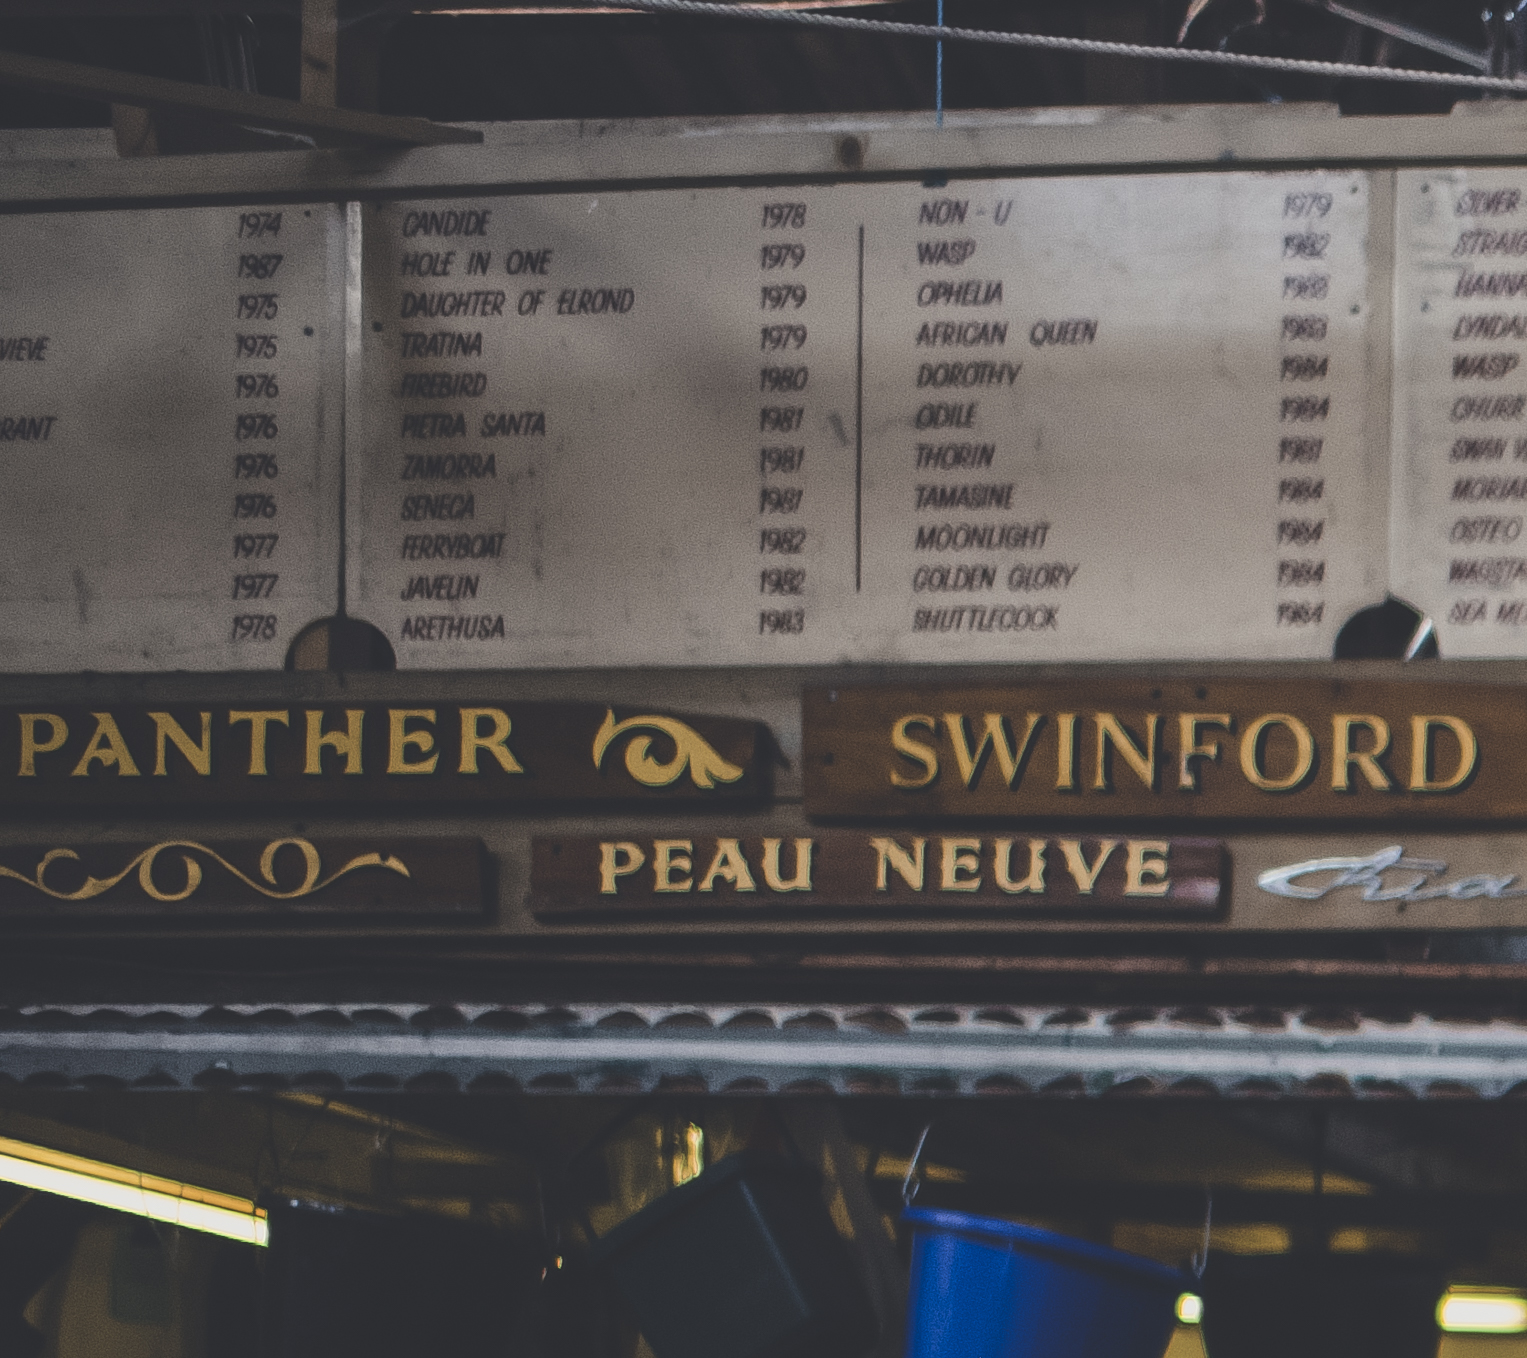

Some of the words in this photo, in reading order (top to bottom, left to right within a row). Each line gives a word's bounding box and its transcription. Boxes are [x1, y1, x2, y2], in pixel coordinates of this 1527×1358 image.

[238, 211, 283, 239] 1974
[401, 209, 492, 238] CANDIDE
[401, 250, 455, 277] HOLE
[468, 248, 493, 276] IN
[504, 247, 554, 276] ONE
[759, 242, 807, 270] 1979
[915, 238, 976, 266] WASP
[236, 291, 279, 321] 1975
[401, 290, 505, 318] DAUGHTER
[517, 288, 546, 317] OF
[556, 287, 636, 315] ELROND
[760, 283, 808, 310] 1979
[916, 279, 1003, 307] OPHELIA
[233, 331, 278, 360] 1975
[401, 331, 484, 359] TRATINA
[758, 323, 808, 355] 1979
[914, 321, 1009, 348] AFRICAN
[1028, 319, 1098, 350] QUEEN
[233, 373, 280, 400] 1976
[400, 371, 488, 399] FIREBIRD
[758, 366, 809, 394] 1980
[914, 360, 1022, 390] DOROTHY
[233, 412, 279, 443] 1976
[400, 412, 467, 440] PIETRA
[480, 411, 548, 438] SANTA
[233, 452, 279, 481] 1976
[400, 452, 498, 481] ZAMORRA
[915, 442, 996, 471] THORIN
[231, 491, 278, 520] 1976
[400, 493, 476, 520] SENECA
[231, 531, 280, 559] 1977
[400, 531, 507, 559] FERRYBOAT
[758, 526, 808, 555] 1982
[914, 521, 1051, 551] MOONLIGHT
[230, 569, 280, 601] 1977
[400, 574, 480, 601] JAVELIN
[758, 566, 807, 596] 1982
[1006, 561, 1079, 592] GLORY
[228, 612, 278, 645] 1978
[400, 614, 506, 641] ARETHUSA
[911, 604, 1058, 633] SHUTTLECOCK
[16, 707, 525, 778] PANTHER
[888, 712, 1482, 794] SWINFORD
[600, 837, 814, 895] PEAU
[872, 837, 1171, 897] NEUVE
